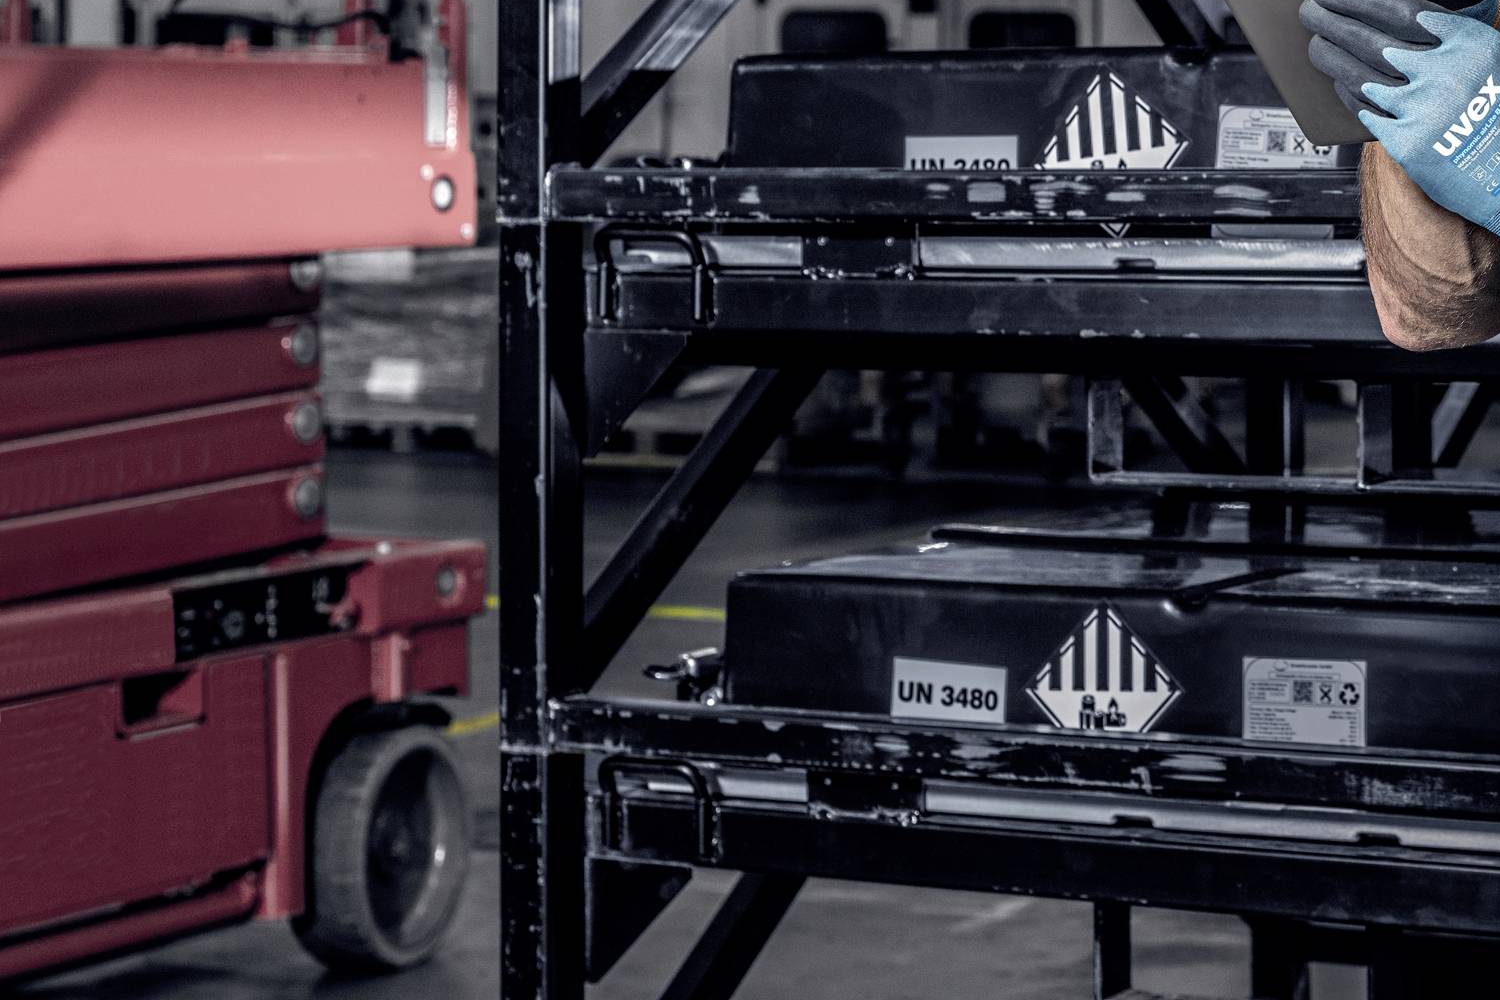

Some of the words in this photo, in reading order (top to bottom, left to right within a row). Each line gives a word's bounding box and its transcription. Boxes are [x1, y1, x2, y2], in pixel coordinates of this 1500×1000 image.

[1453, 134, 1481, 164] phynomic
[899, 680, 932, 704] UN
[941, 685, 998, 711] 3480
